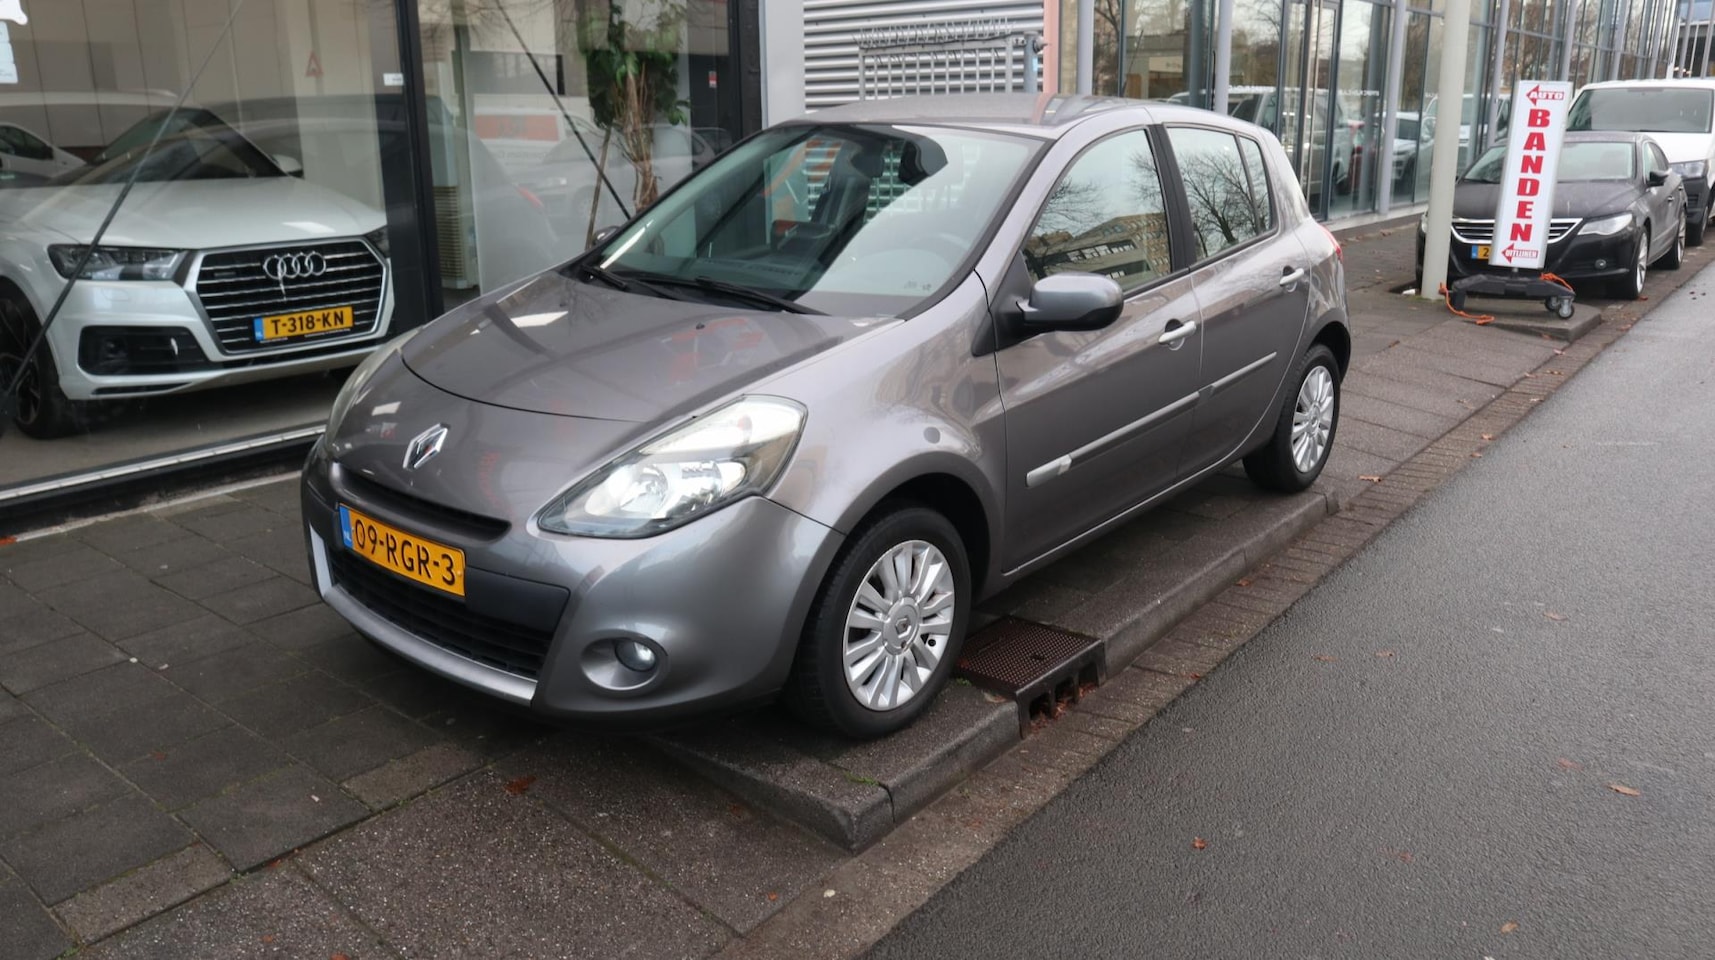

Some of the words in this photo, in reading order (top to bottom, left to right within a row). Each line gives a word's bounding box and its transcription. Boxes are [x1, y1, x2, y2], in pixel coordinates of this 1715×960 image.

[1529, 91, 1563, 100] AUTO
[1510, 108, 1551, 242] BANDEN
[270, 310, 345, 335] T-318-KN
[355, 519, 456, 586] 09-RGR-3
